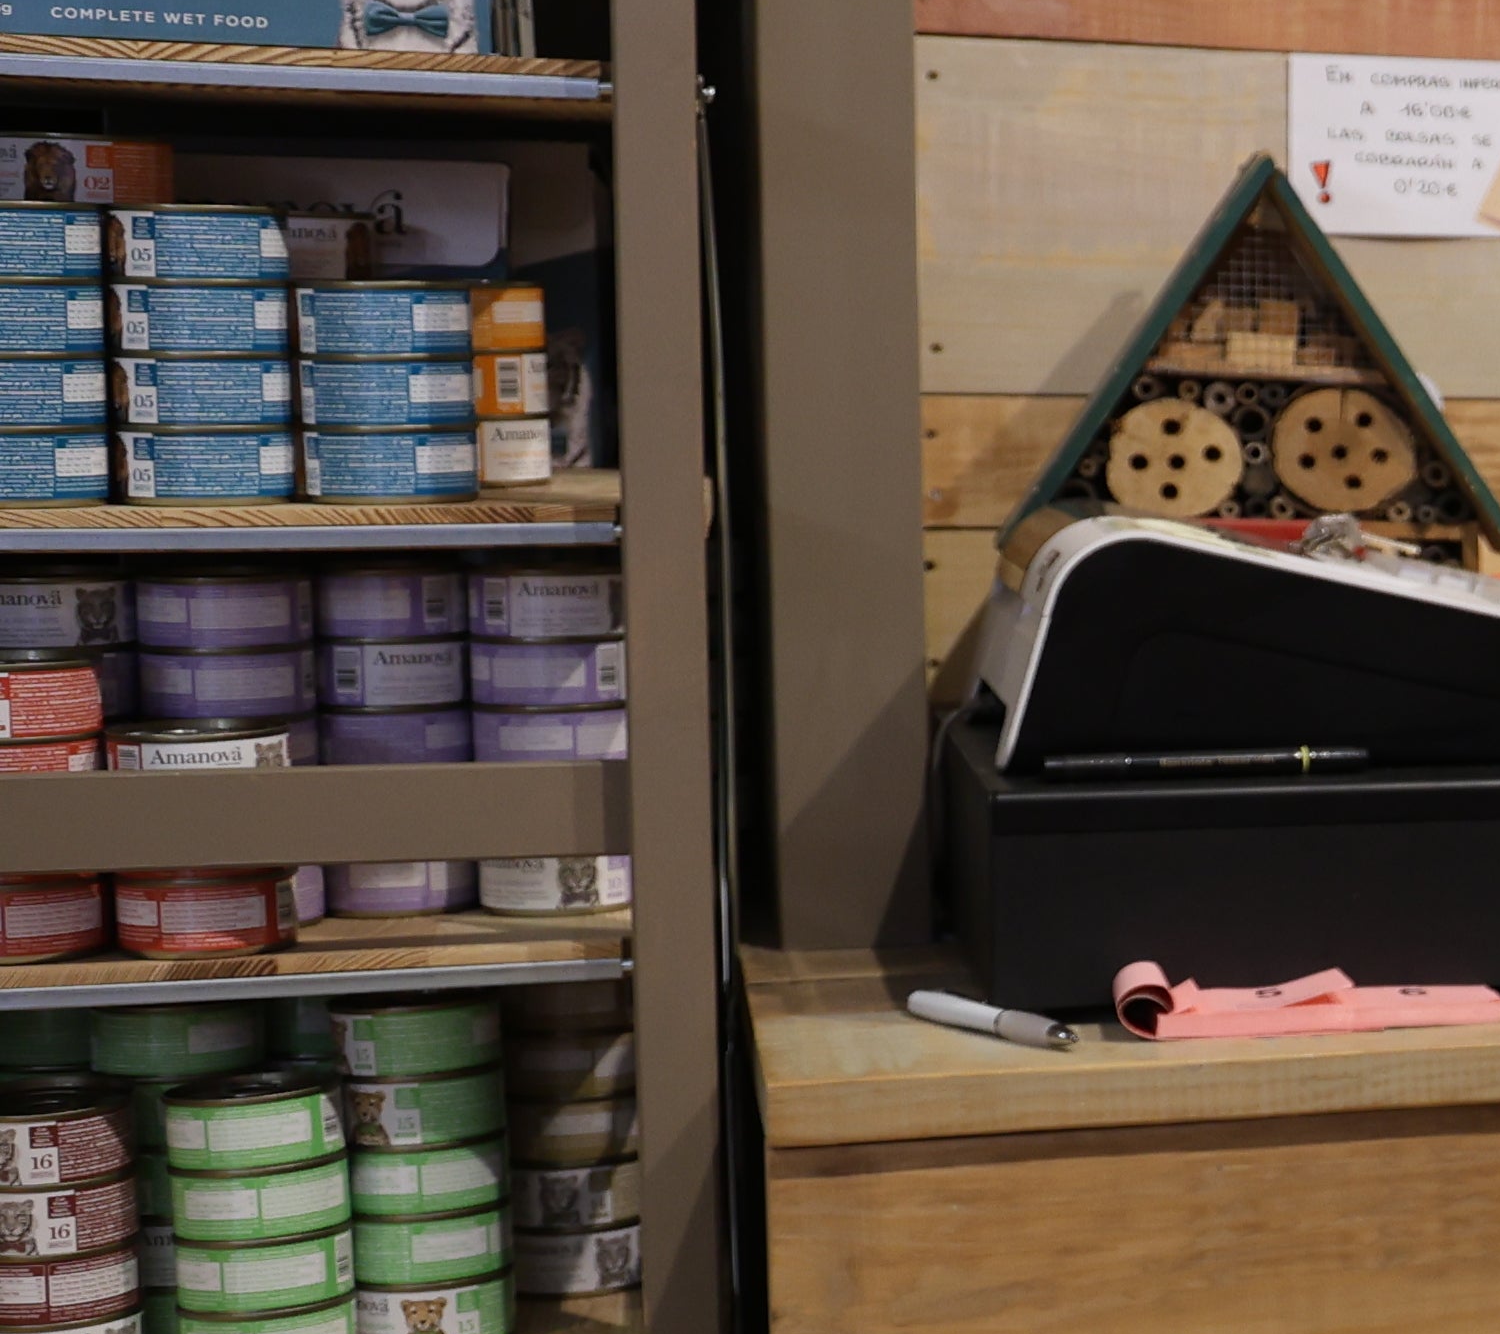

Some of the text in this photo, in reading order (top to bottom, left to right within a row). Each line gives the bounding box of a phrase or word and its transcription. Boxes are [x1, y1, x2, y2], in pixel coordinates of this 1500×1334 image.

[51, 5, 155, 24] COMPLETE
[163, 12, 207, 26] WET
[214, 14, 269, 30] FOOD
[131, 246, 152, 263] 05
[126, 320, 146, 336] 05
[133, 393, 155, 410] 05
[132, 466, 151, 483] 05
[31, 1153, 53, 1170] 16
[48, 1223, 71, 1240] 16
